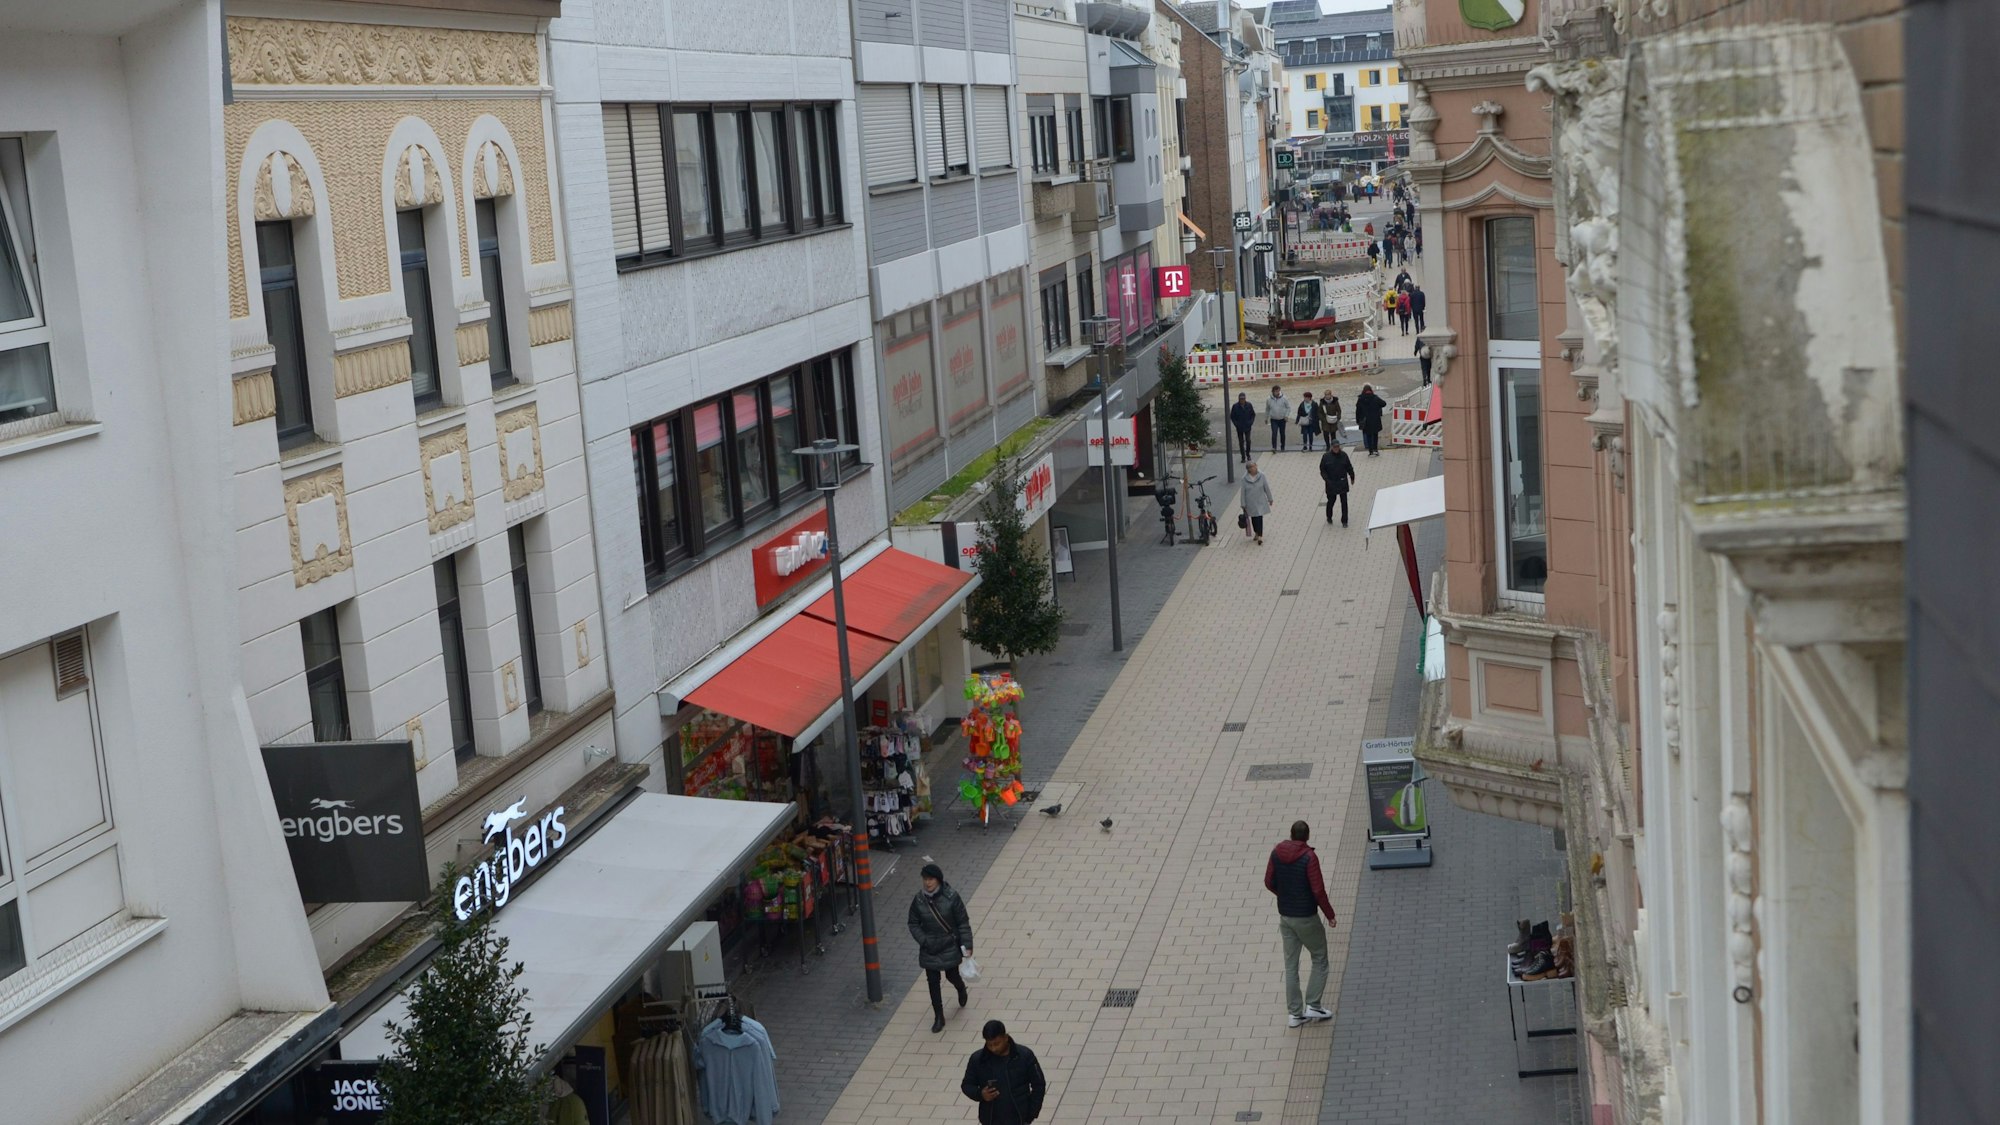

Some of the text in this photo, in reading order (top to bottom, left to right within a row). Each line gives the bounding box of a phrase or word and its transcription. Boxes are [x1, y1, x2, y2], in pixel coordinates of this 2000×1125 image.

[1165, 270, 1183, 293] T
[1111, 436, 1130, 447] john
[280, 809, 404, 843] engbers
[454, 806, 567, 921] engbers
[330, 1079, 381, 1095] JACK
[333, 1095, 387, 1111] JONE
